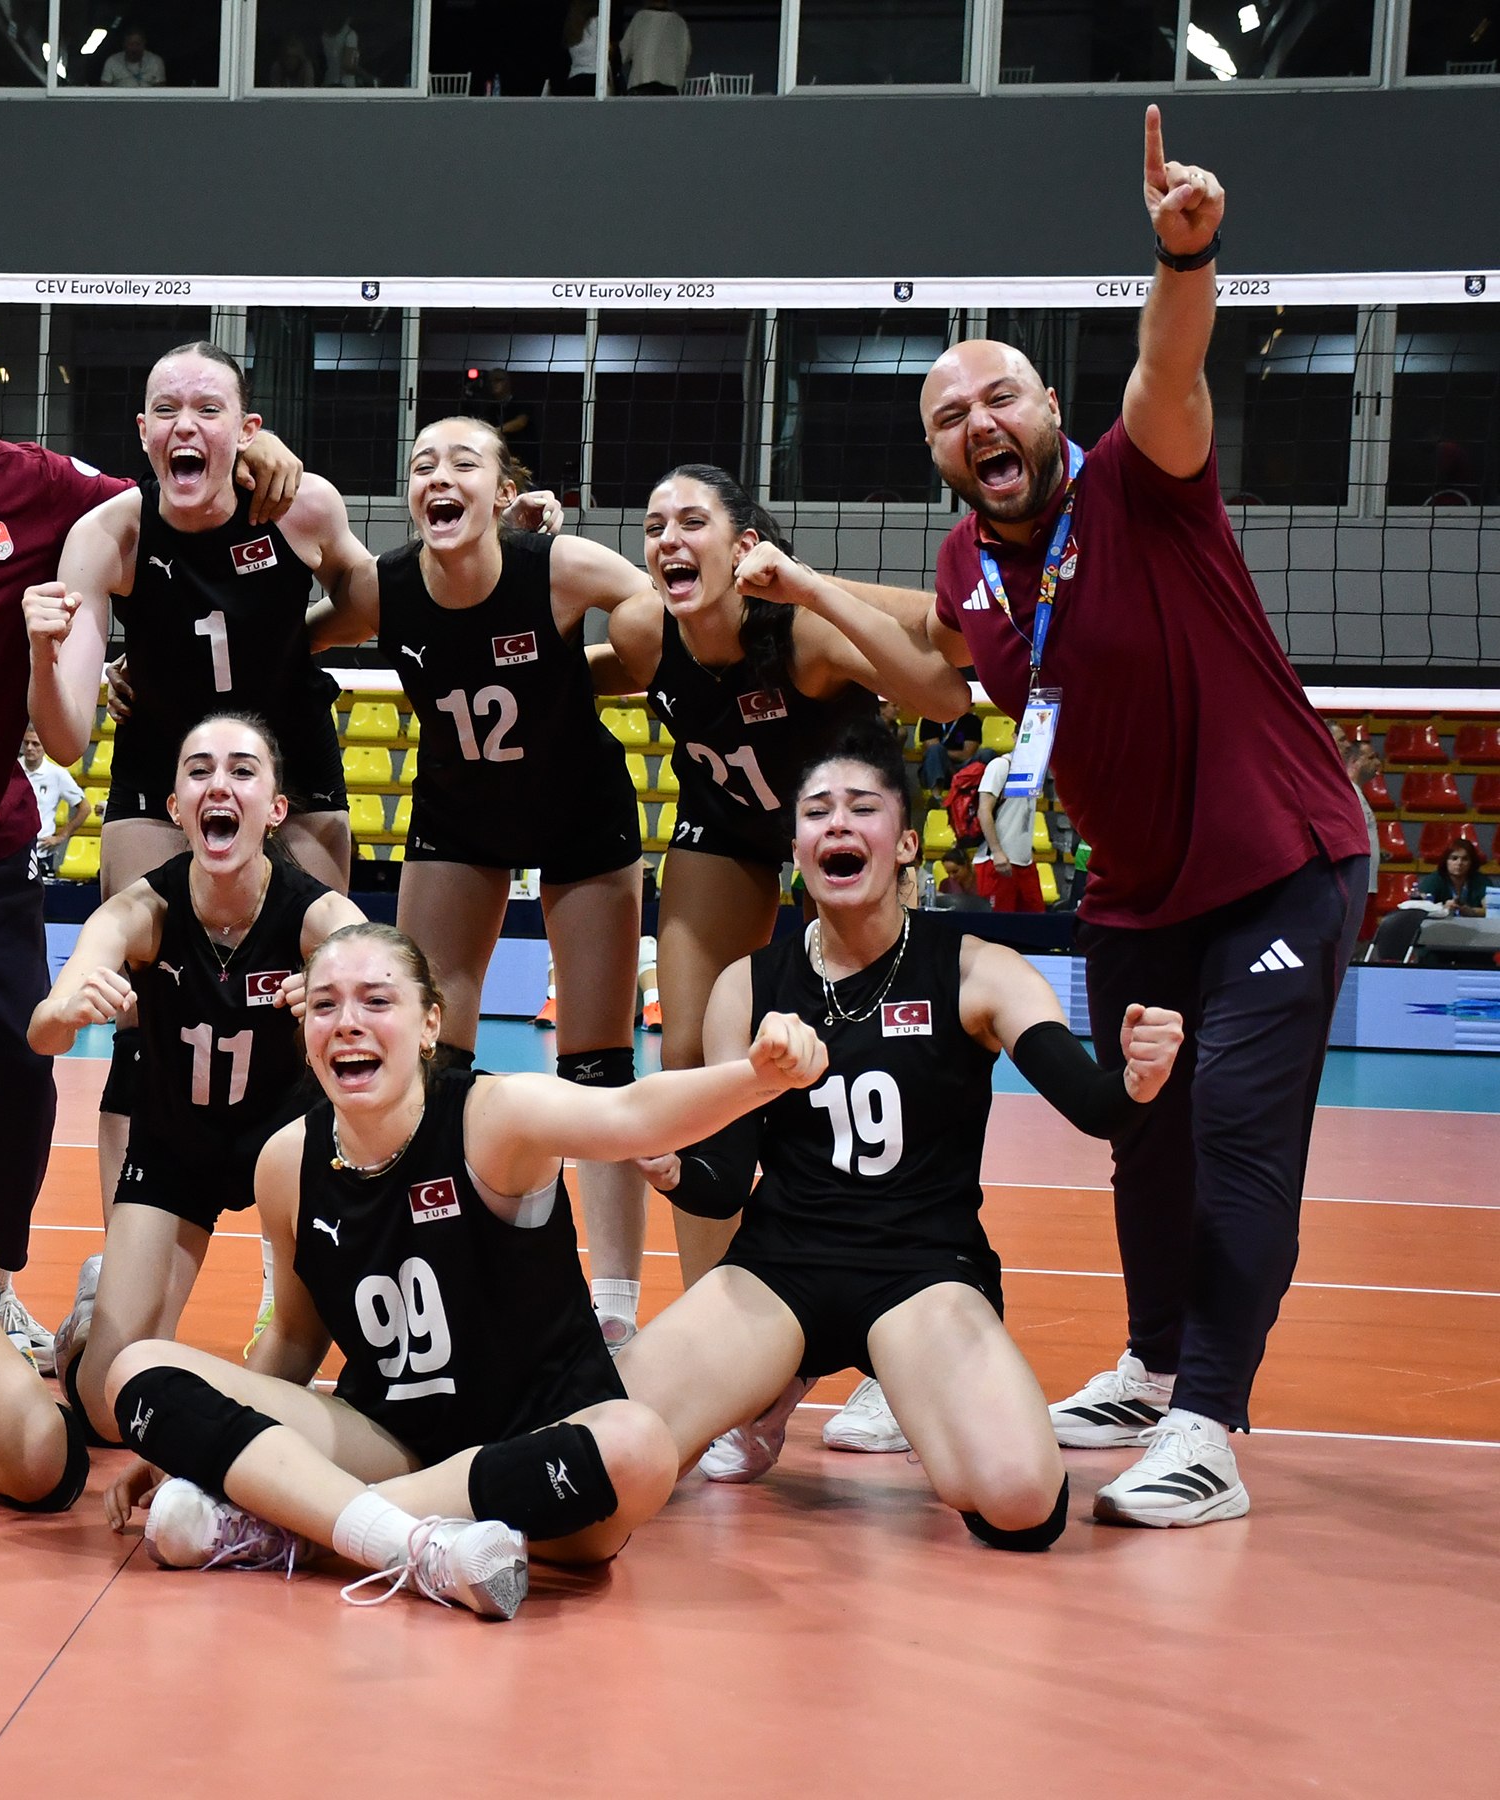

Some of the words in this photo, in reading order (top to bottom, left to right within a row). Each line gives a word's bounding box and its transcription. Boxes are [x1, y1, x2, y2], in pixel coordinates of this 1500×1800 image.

[35, 280, 67, 294] CEV
[71, 280, 150, 298] EuroVolley
[154, 281, 191, 295] 2023
[552, 283, 585, 298] CEV
[589, 283, 672, 301] EuroVolley
[676, 283, 715, 298] 2023
[1095, 282, 1131, 297] CEV
[1229, 280, 1271, 295] 2023
[245, 560, 269, 572] TUR
[194, 610, 232, 693] 1
[504, 654, 529, 664] TUR
[435, 684, 525, 762] 12
[752, 711, 778, 721] TUR
[685, 742, 782, 811] 21
[257, 995, 273, 1004] TU
[893, 1026, 921, 1035] TUR
[180, 1022, 254, 1106] 11
[808, 1070, 904, 1177] 19
[423, 1207, 449, 1220] TUR
[354, 1256, 452, 1378] 99
